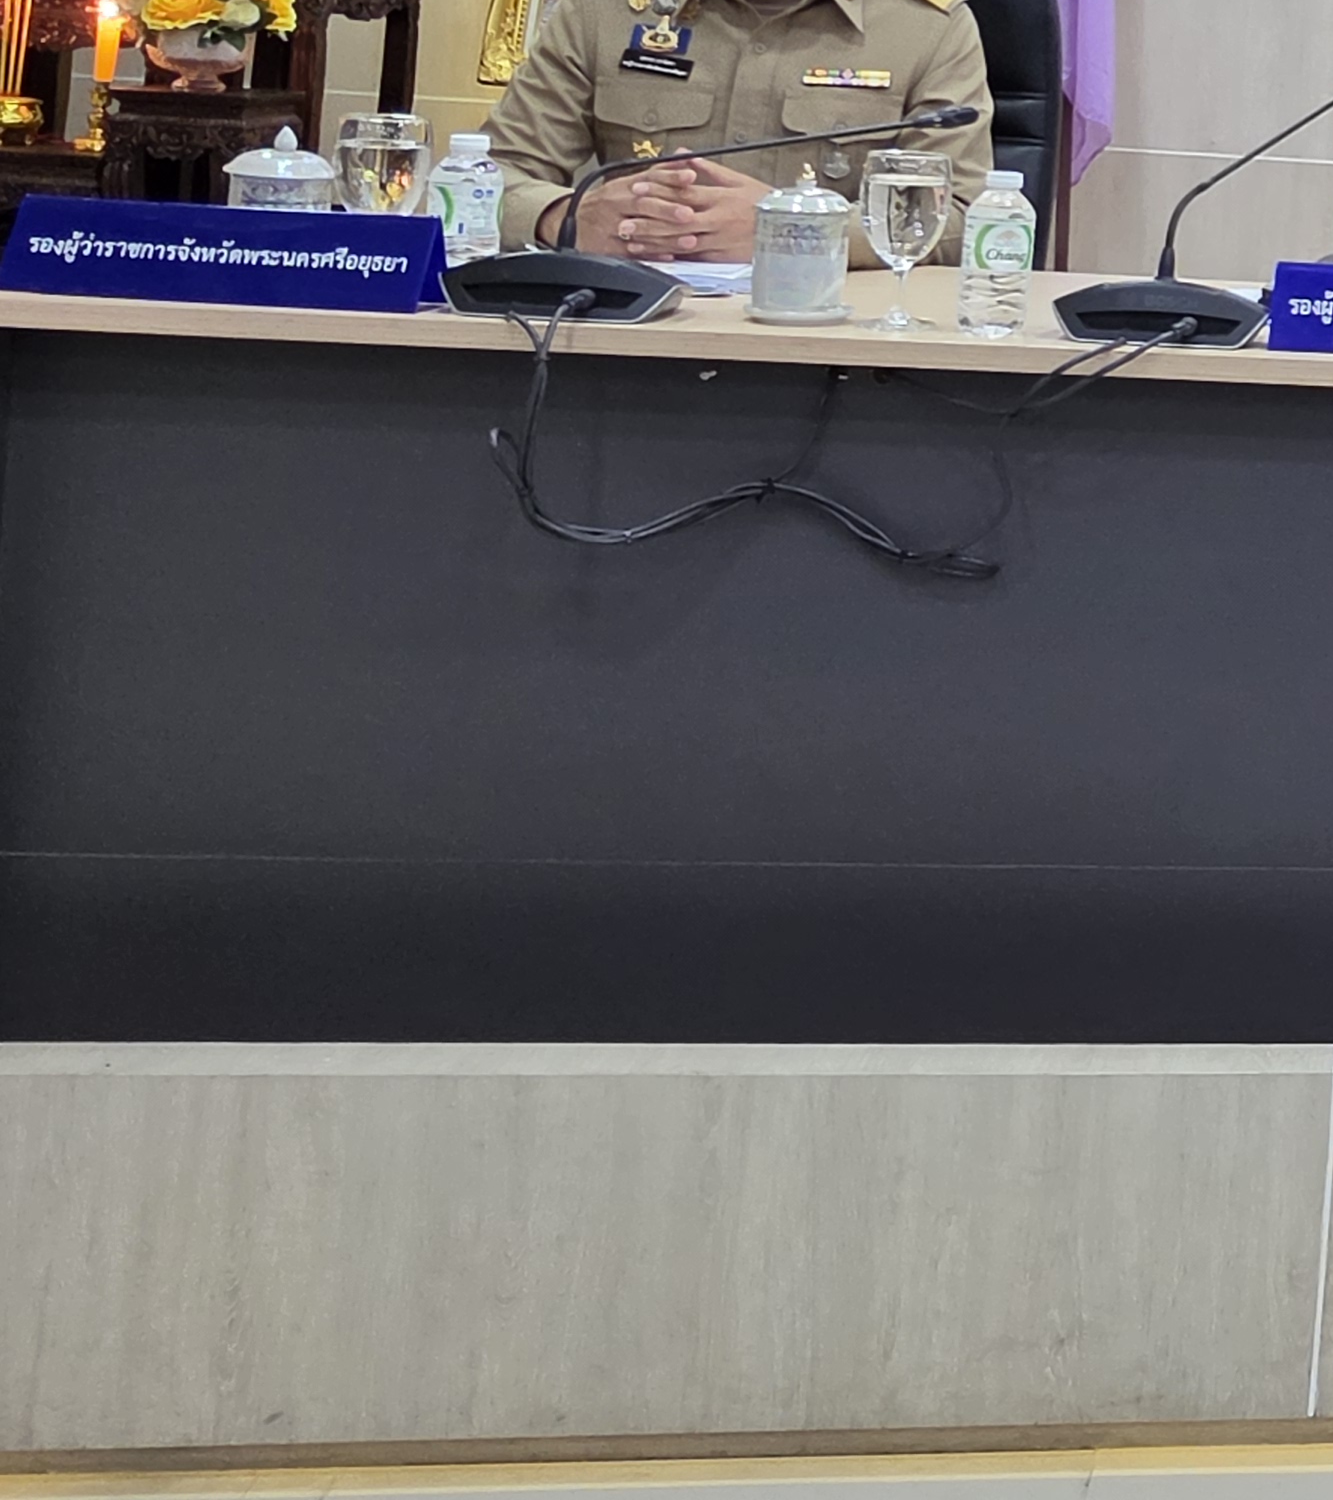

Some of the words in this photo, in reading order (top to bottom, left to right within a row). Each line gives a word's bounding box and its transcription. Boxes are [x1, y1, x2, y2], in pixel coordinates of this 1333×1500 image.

[29, 231, 408, 278] รองผู้ว่าราชการจังหวัดพระนครศรีอยุธยา
